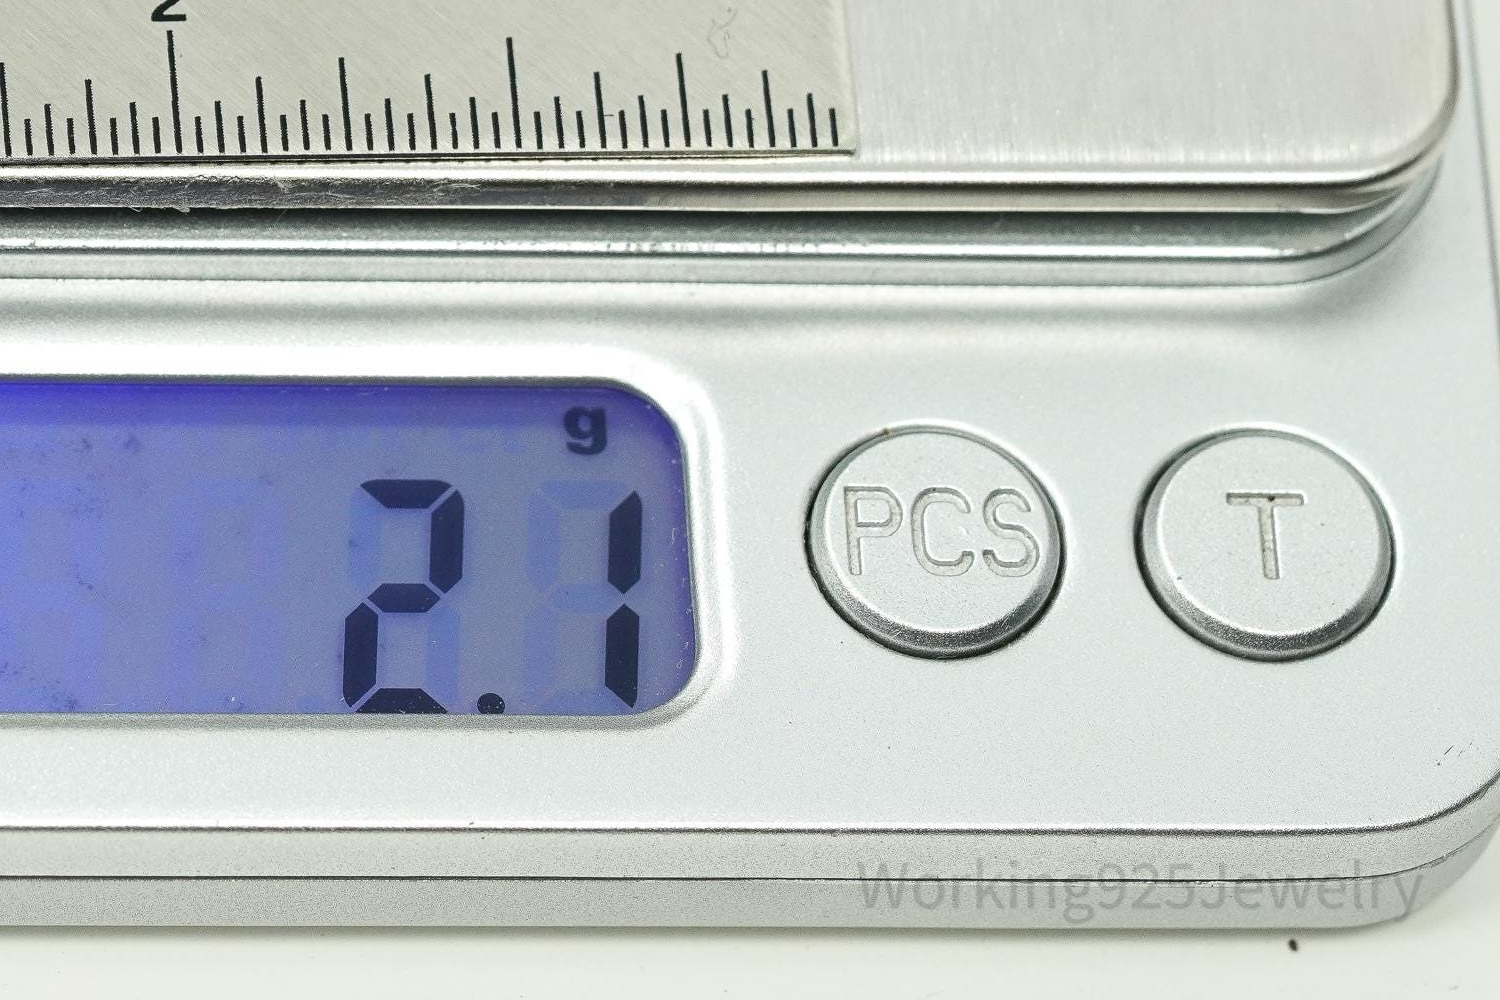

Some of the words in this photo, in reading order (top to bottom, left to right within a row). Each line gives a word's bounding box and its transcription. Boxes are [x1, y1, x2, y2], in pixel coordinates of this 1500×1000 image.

[562, 405, 608, 456] g
[842, 485, 1042, 578] PCS
[1225, 491, 1306, 581] T
[343, 479, 644, 715] 2.1
